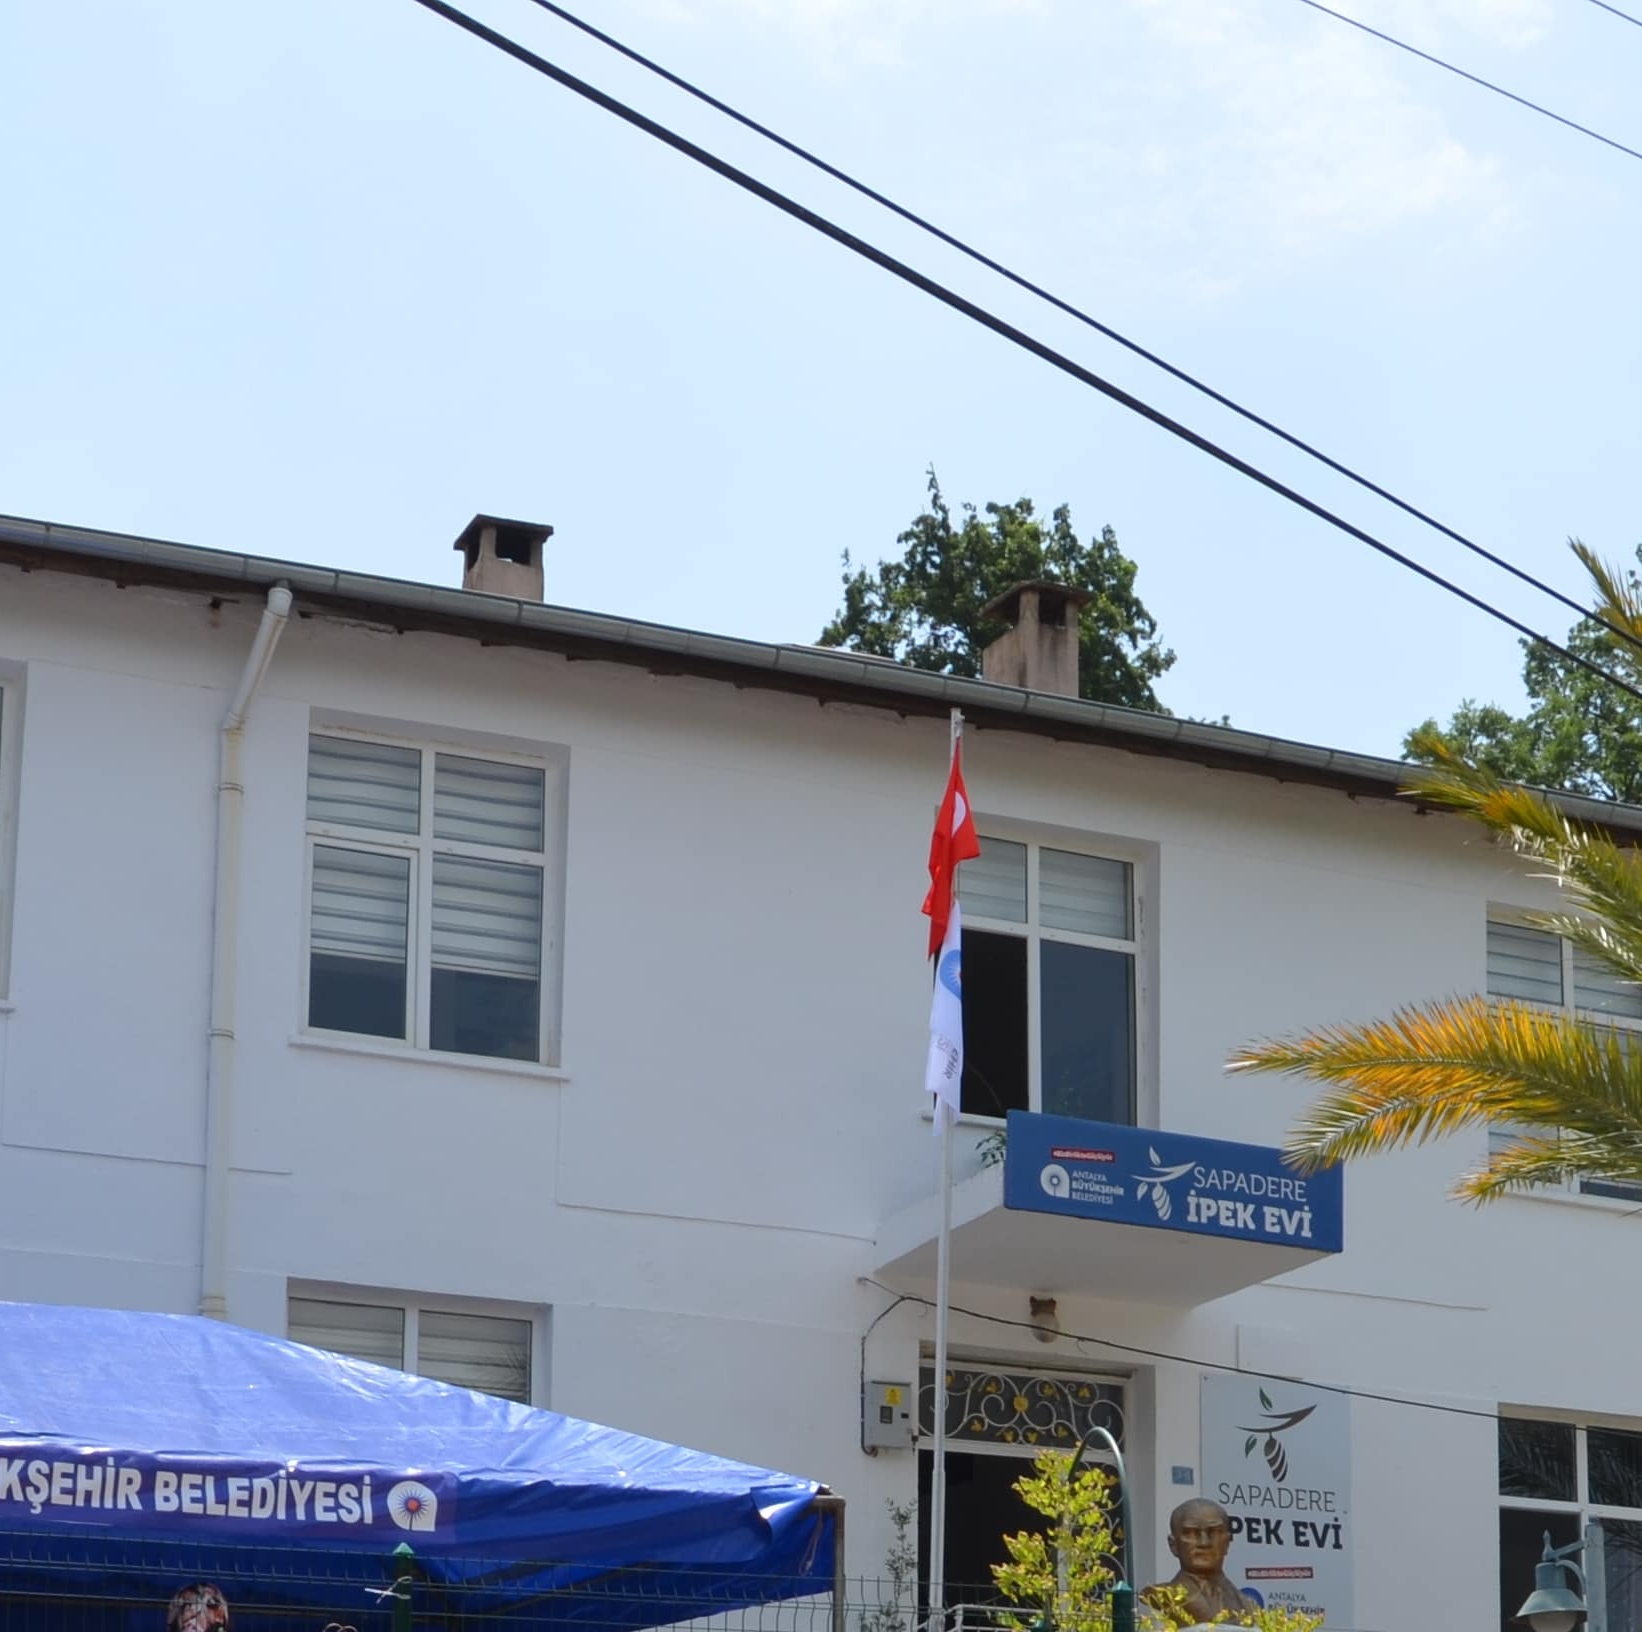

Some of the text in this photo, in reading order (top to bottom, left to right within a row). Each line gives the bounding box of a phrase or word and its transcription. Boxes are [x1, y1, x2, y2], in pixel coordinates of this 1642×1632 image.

[1193, 1167, 1307, 1202] SAPADERE
[1187, 1190, 1312, 1238] İPEK EVİ
[154, 1471, 374, 1525] BELEDİYESİ
[1218, 1482, 1337, 1513] SAPADERE
[1227, 1515, 1343, 1550] PEK EVİ
